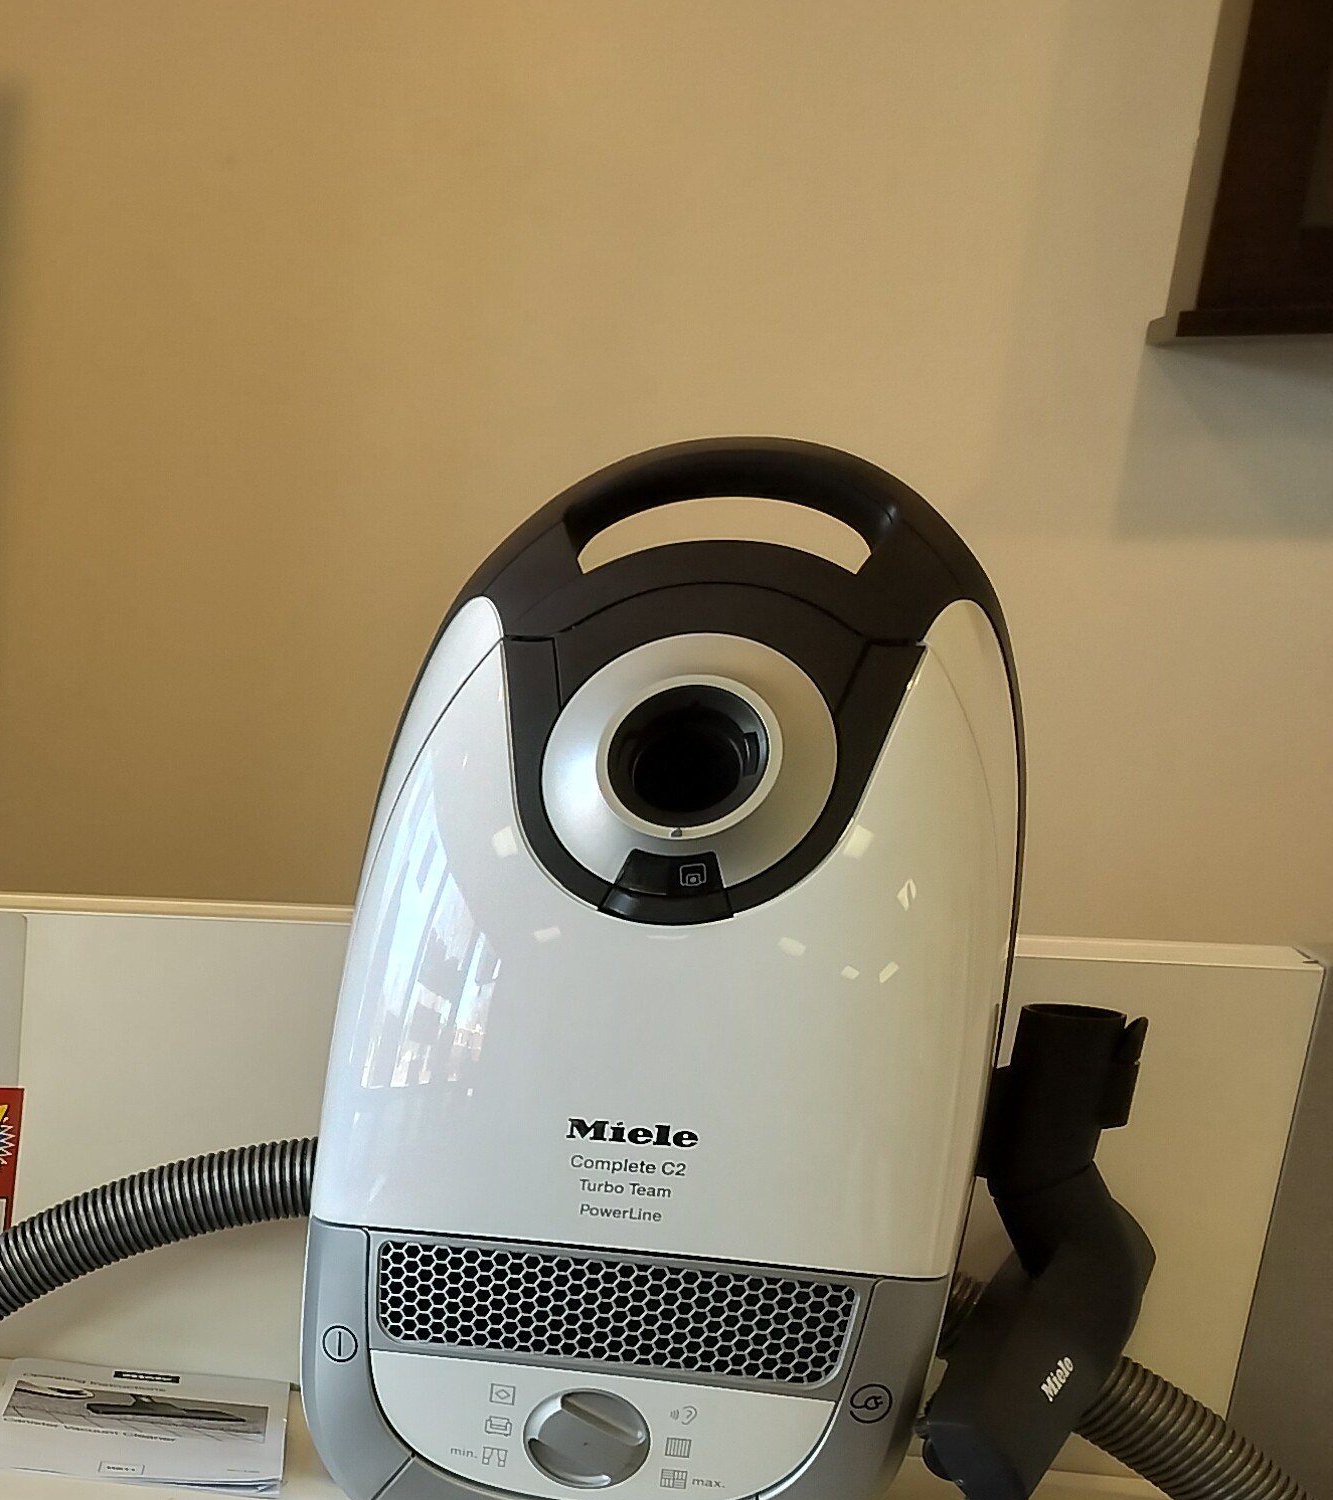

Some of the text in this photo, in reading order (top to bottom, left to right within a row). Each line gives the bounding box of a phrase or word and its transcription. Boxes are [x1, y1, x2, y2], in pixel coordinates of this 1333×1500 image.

[566, 1118, 698, 1148] Miele
[571, 1154, 686, 1176] Complete C2
[579, 1179, 671, 1198] Turbo Team
[580, 1203, 662, 1222] PowerLine
[1040, 1357, 1074, 1402] Miele
[450, 1446, 478, 1459] min.
[691, 1477, 726, 1489] max.
